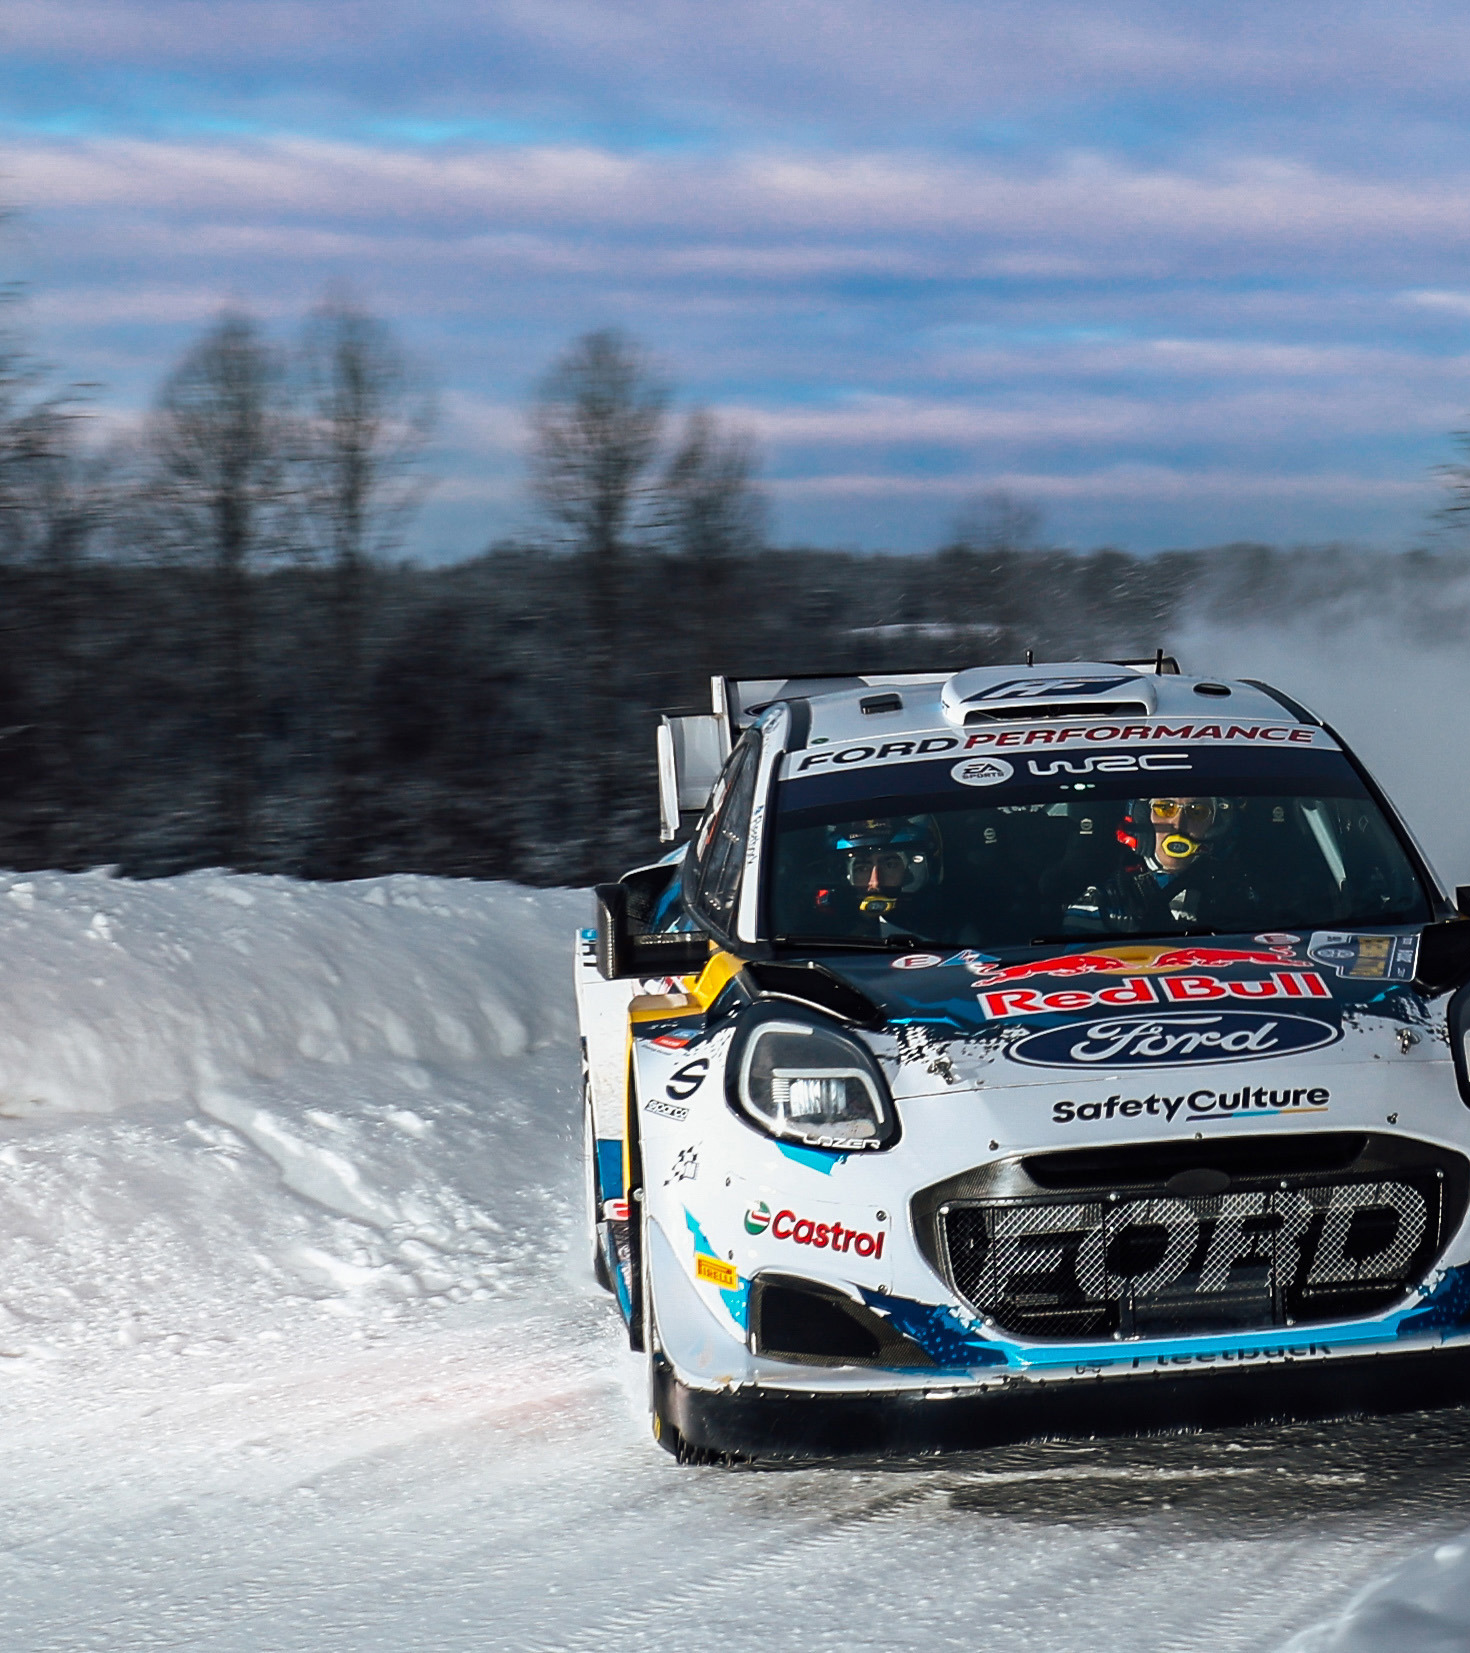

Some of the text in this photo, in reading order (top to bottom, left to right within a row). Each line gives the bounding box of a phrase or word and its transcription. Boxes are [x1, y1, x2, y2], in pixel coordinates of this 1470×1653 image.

[797, 724, 1316, 772] FORD PERFORMANCE
[1028, 753, 1193, 776] WRC
[979, 972, 1331, 1019] Red Bull
[1070, 1015, 1279, 1062] Ford
[1052, 1086, 1330, 1124] SafetyCulture
[802, 1134, 881, 1150] LAZER
[771, 1209, 886, 1260] Castrol
[970, 1181, 1429, 1310] FORD
[697, 1258, 734, 1285] PIRELLI
